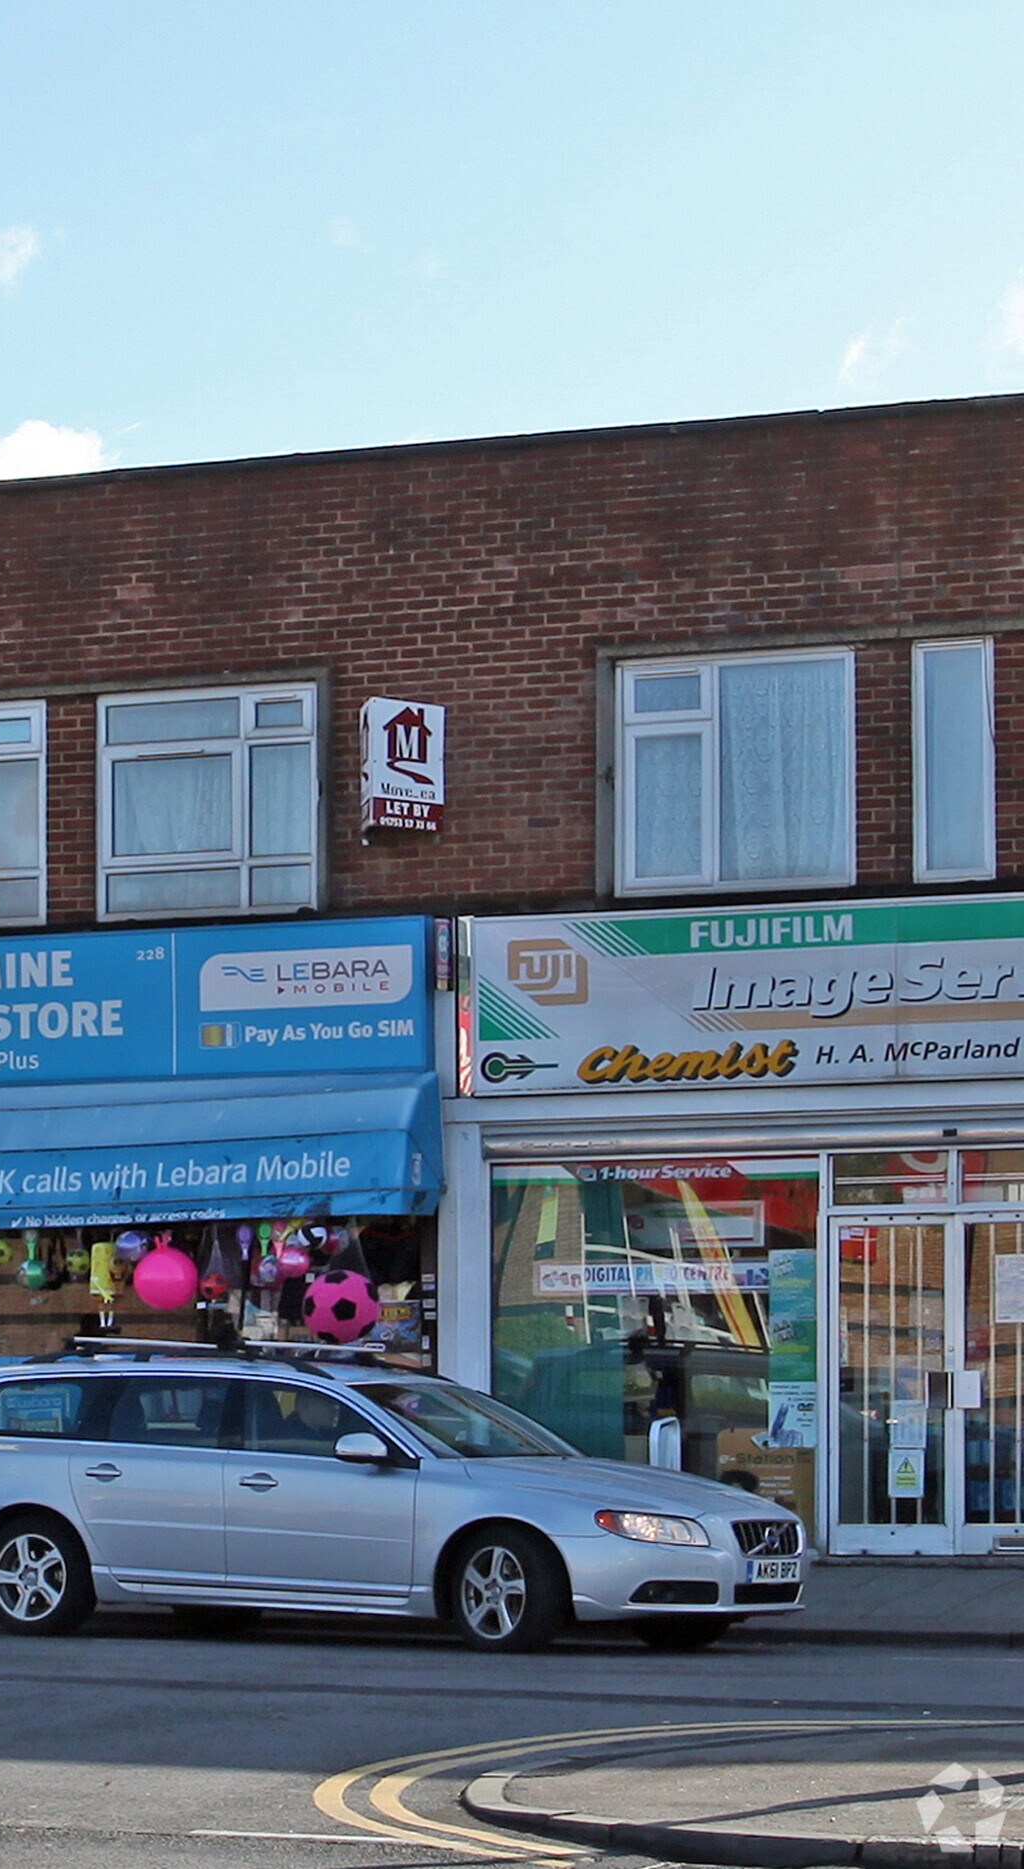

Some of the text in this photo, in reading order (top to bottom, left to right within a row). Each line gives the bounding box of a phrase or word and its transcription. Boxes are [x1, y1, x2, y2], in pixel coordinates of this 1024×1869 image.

[385, 801, 431, 818] LET BY
[690, 914, 853, 948] FUJIFILM
[136, 947, 165, 961] 228
[277, 959, 390, 981] LEBARA
[293, 981, 390, 994] MOBILE
[693, 956, 1024, 1018] ImageSer
[244, 1019, 414, 1047] Pay As You Go SIM
[577, 1039, 799, 1084] Chemist
[816, 1036, 1021, 1065] H. A. McParland
[21, 1165, 82, 1194] calls
[90, 1163, 147, 1190] with
[156, 1158, 248, 1188] Lebara
[255, 1150, 351, 1182] Mobile
[661, 1162, 732, 1179] Service
[25, 1215, 42, 1228] No
[44, 1213, 84, 1226] hidden
[86, 1211, 132, 1225] charges
[134, 1212, 148, 1222] or
[149, 1209, 189, 1222] access
[191, 1206, 226, 1219] codes
[583, 1266, 631, 1283] DIGITAL
